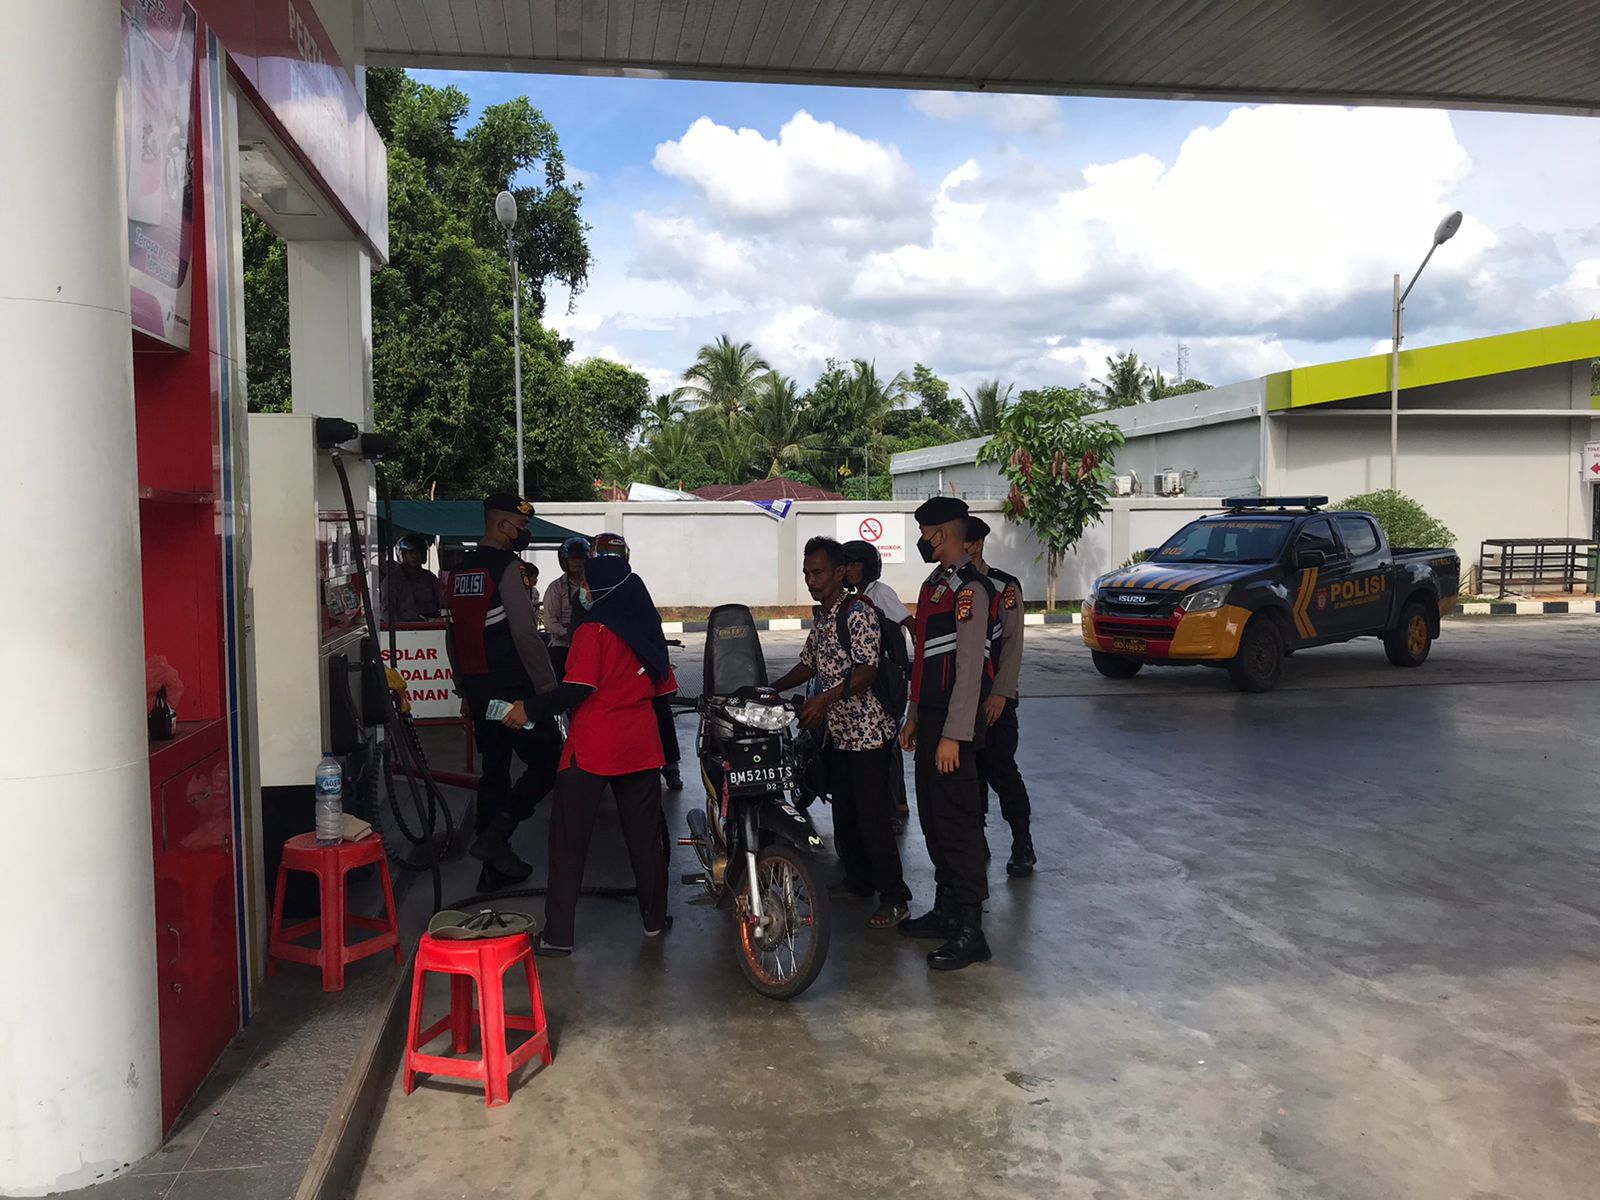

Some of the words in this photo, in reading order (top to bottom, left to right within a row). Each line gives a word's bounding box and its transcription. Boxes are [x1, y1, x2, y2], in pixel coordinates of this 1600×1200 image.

[453, 574, 485, 594] POLISI
[1330, 574, 1387, 602] POLISI
[1118, 595, 1146, 603] ISUZU
[380, 648, 438, 661] SOLAR
